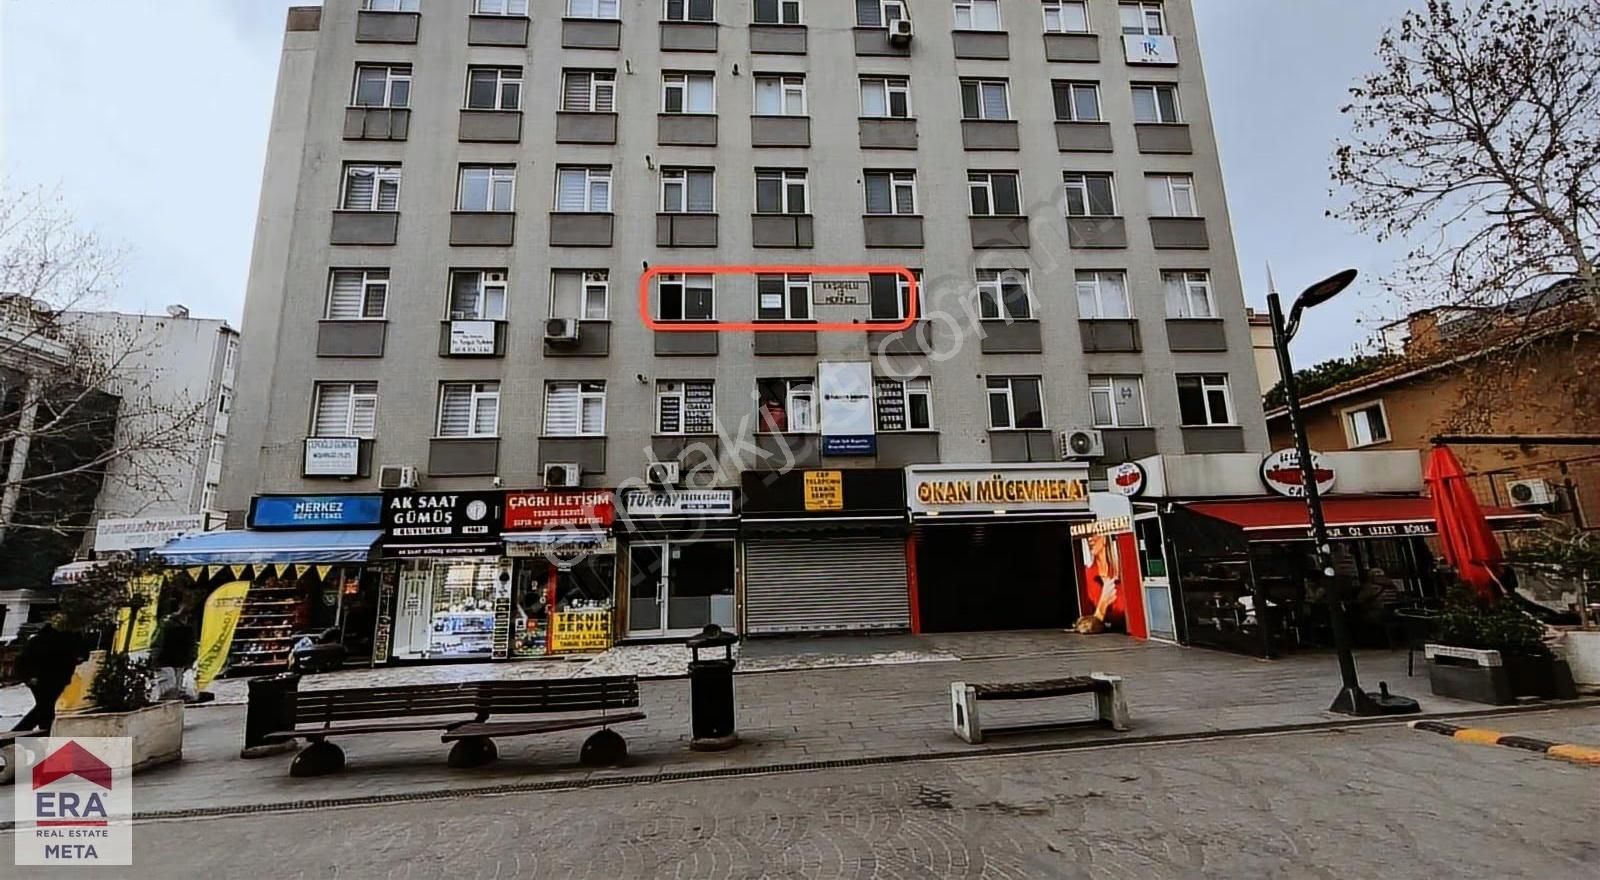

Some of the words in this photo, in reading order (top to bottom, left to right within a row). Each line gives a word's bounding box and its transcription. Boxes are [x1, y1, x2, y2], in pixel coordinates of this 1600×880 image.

[918, 480, 971, 504] OKAN
[976, 474, 1088, 503] MÜCEVHERAT
[390, 497, 412, 509] AK
[418, 495, 459, 508] SAAT
[554, 491, 609, 508] İLETİŞİM
[629, 494, 680, 508] TURGAY
[294, 502, 344, 513] MERKEZ
[393, 509, 453, 524] GÜMÜŞ
[1368, 525, 1397, 536] LEZZET
